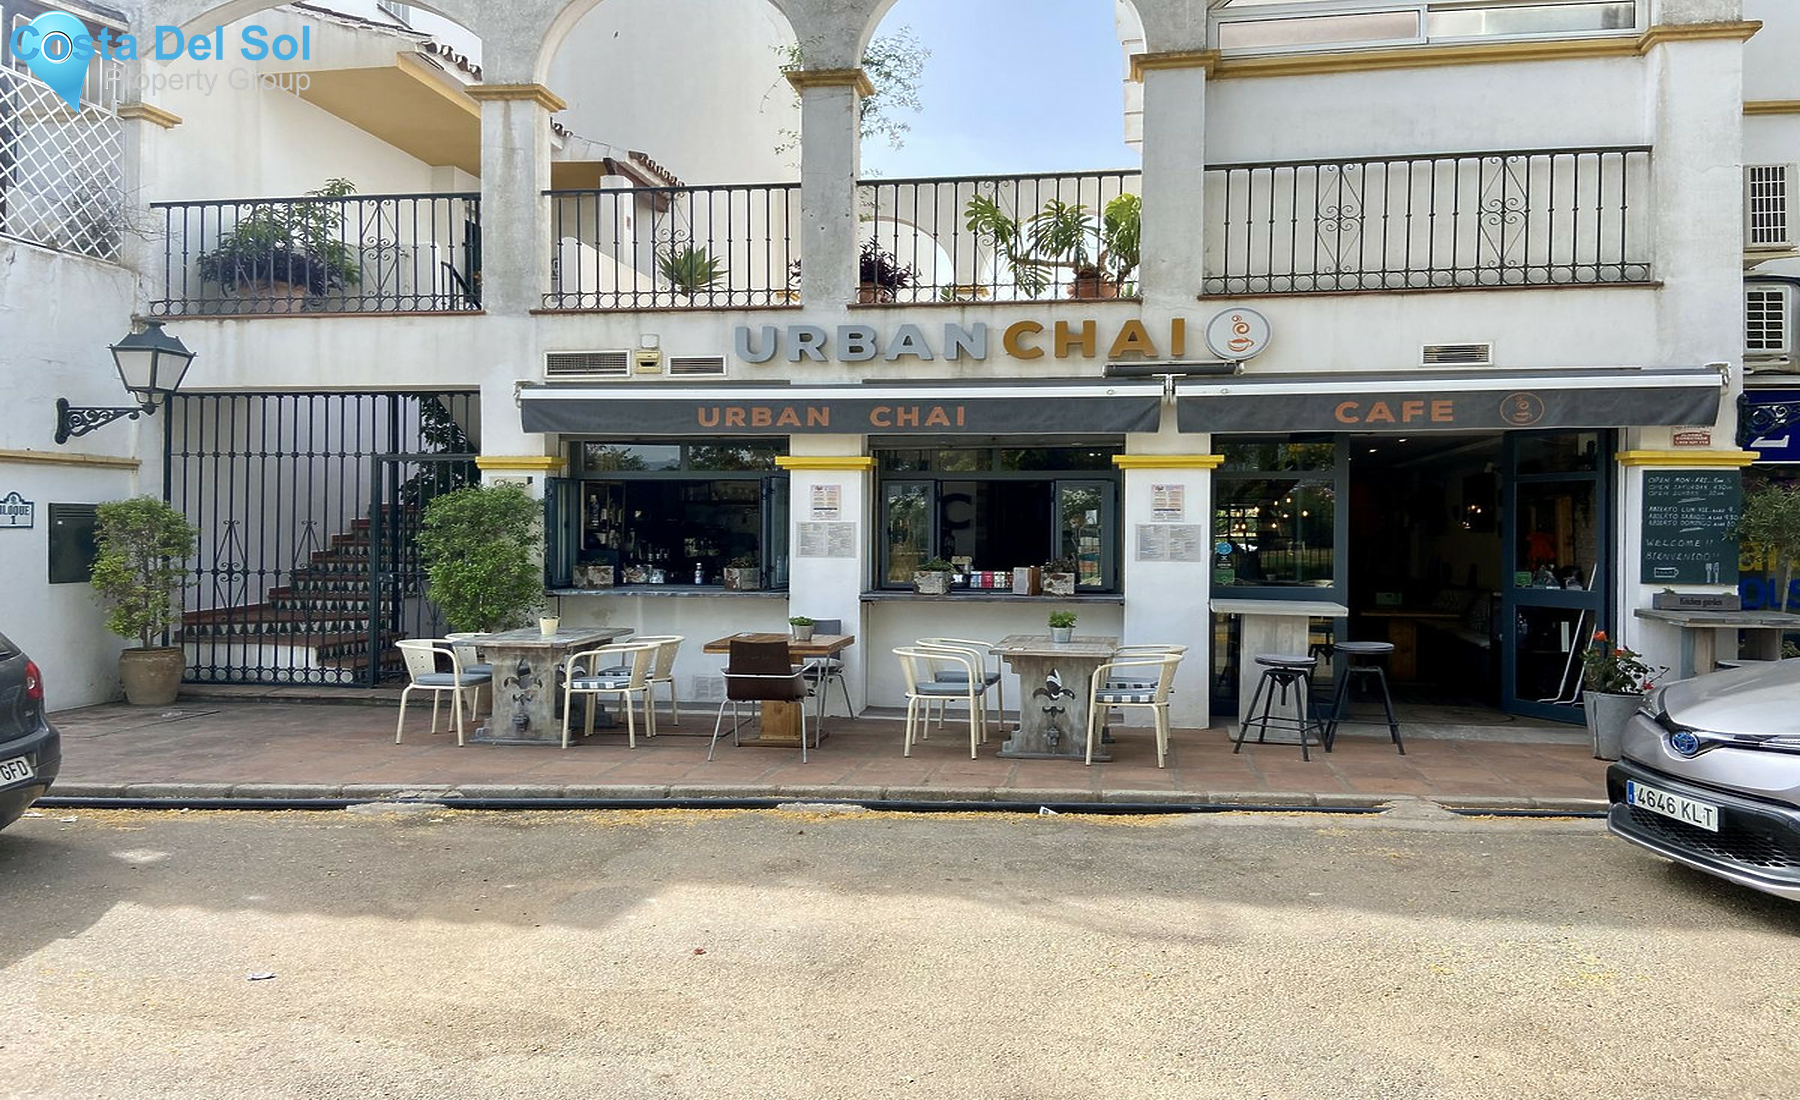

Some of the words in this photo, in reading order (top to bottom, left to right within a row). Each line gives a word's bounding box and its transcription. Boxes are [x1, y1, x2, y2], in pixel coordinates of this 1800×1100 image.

[735, 323, 987, 363] URBAN
[1002, 318, 1186, 360] CHAI
[697, 406, 831, 428] URBAN
[869, 406, 966, 427] CHAI
[1335, 400, 1454, 424] CAFE
[1646, 539, 1701, 547] WELCOME
[0, 760, 28, 781] GFD
[1637, 788, 1676, 815] 4646
[1681, 801, 1713, 827] KLT
